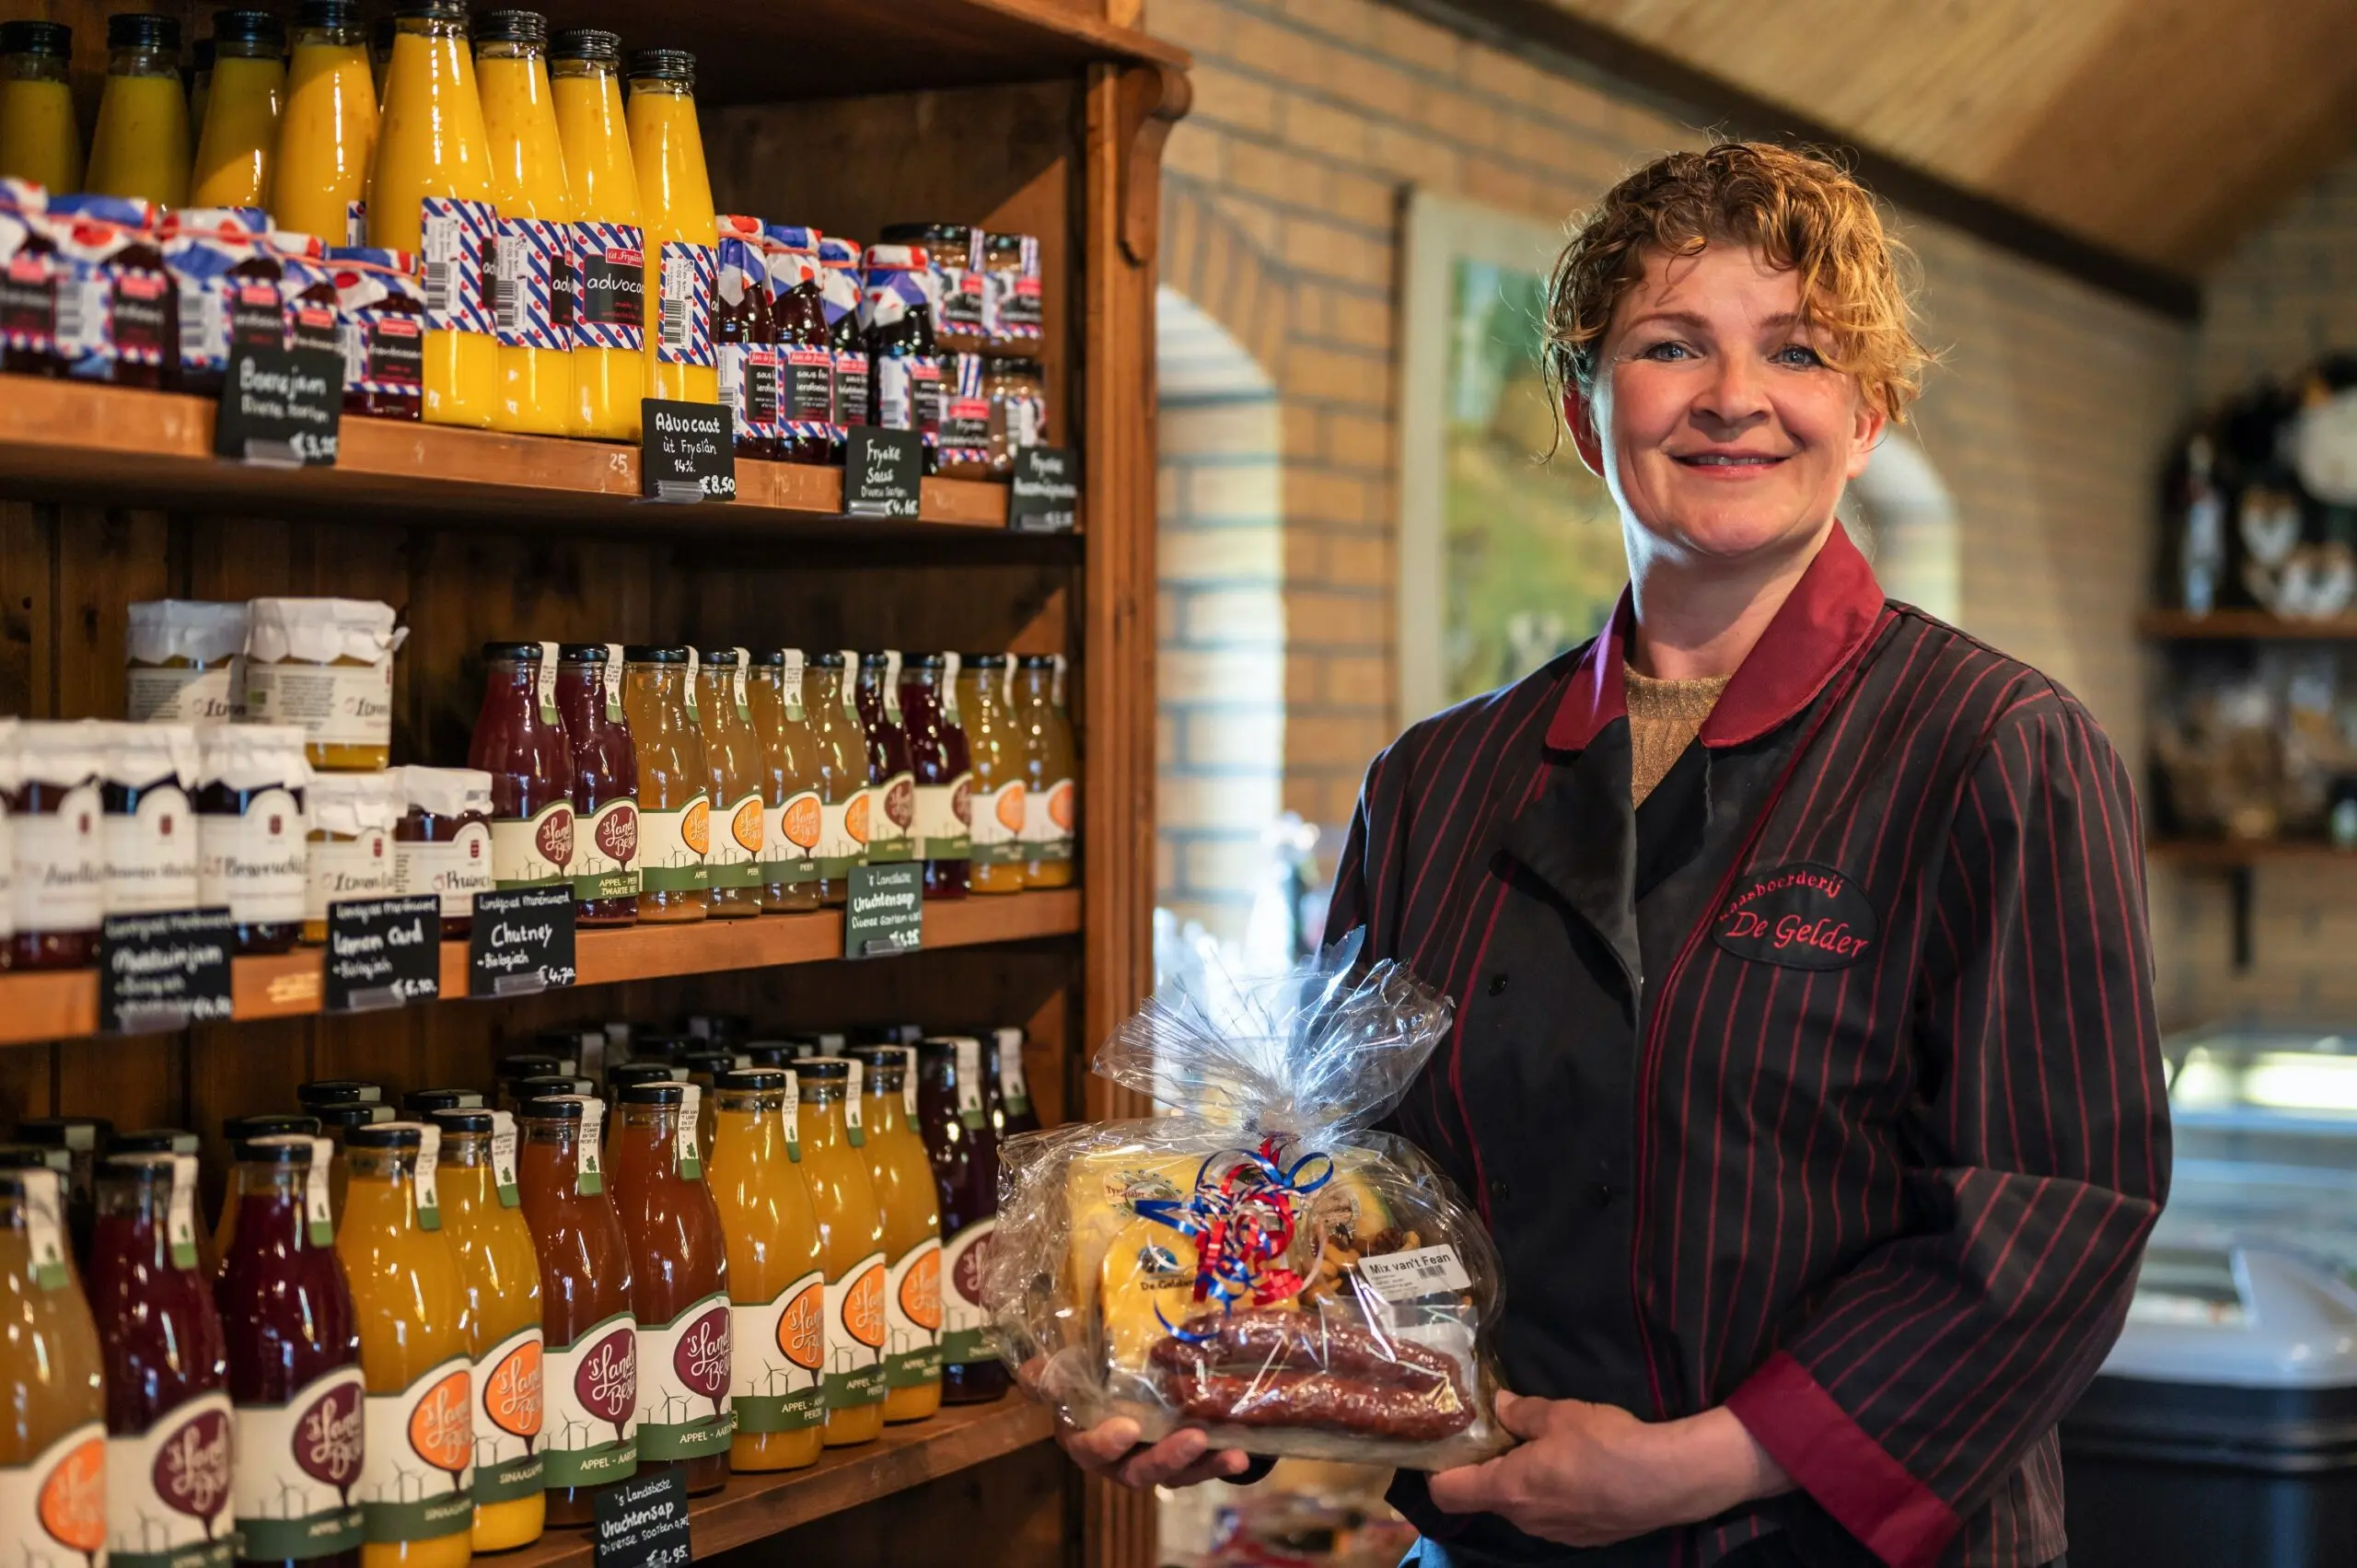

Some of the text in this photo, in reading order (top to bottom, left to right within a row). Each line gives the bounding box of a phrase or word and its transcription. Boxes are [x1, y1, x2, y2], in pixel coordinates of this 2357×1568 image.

[655, 412, 721, 434] Advocaat
[599, 878, 621, 888] APPEL
[601, 887, 628, 896] ZWARTE
[491, 921, 552, 949] Chutney
[1724, 911, 1869, 958] De Gelder
[1369, 1253, 1452, 1274] Mix van't Fean
[782, 1400, 807, 1413] APPEL
[679, 1430, 707, 1444] APPEL
[580, 1456, 610, 1471] APPEL
